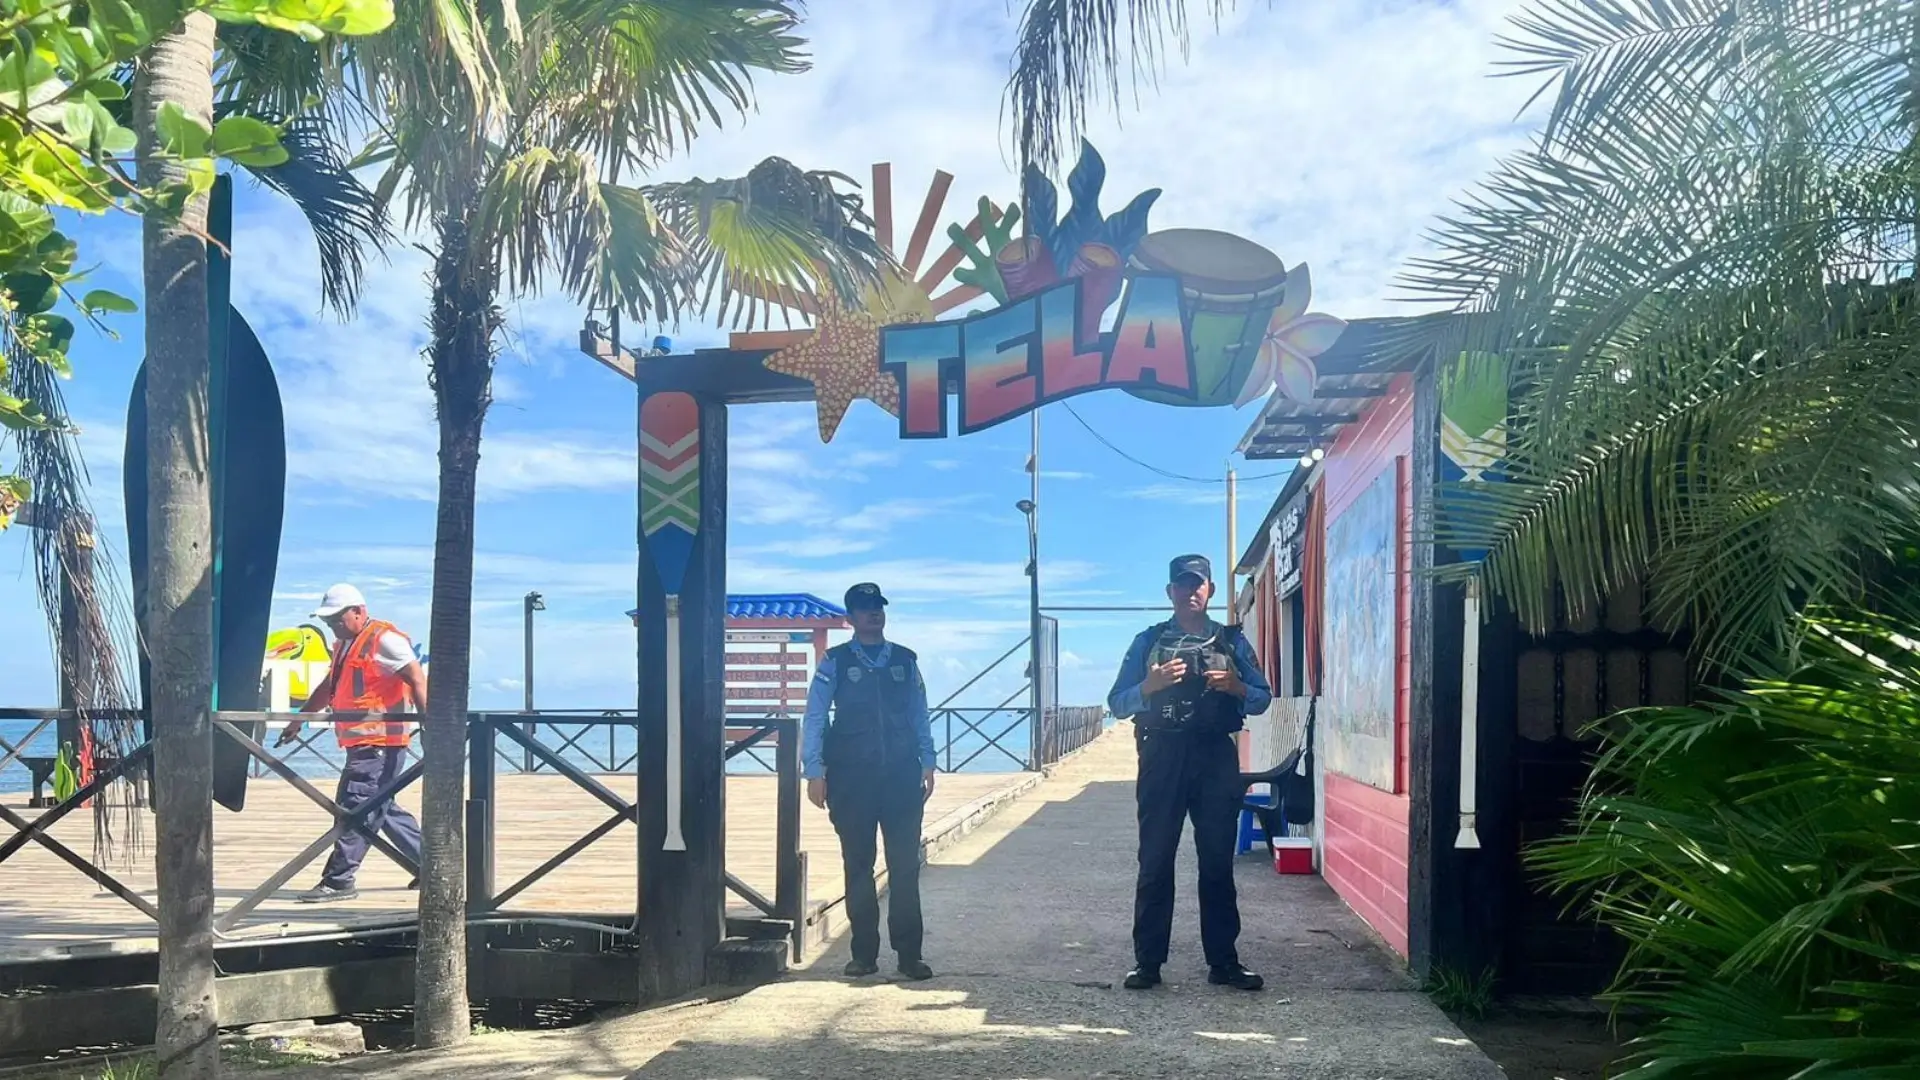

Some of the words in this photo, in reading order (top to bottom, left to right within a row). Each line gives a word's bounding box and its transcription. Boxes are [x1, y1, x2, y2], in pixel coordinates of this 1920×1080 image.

[880, 275, 1197, 439] TELA
[756, 670, 801, 681] MARINO
[758, 688, 788, 699] TELA
